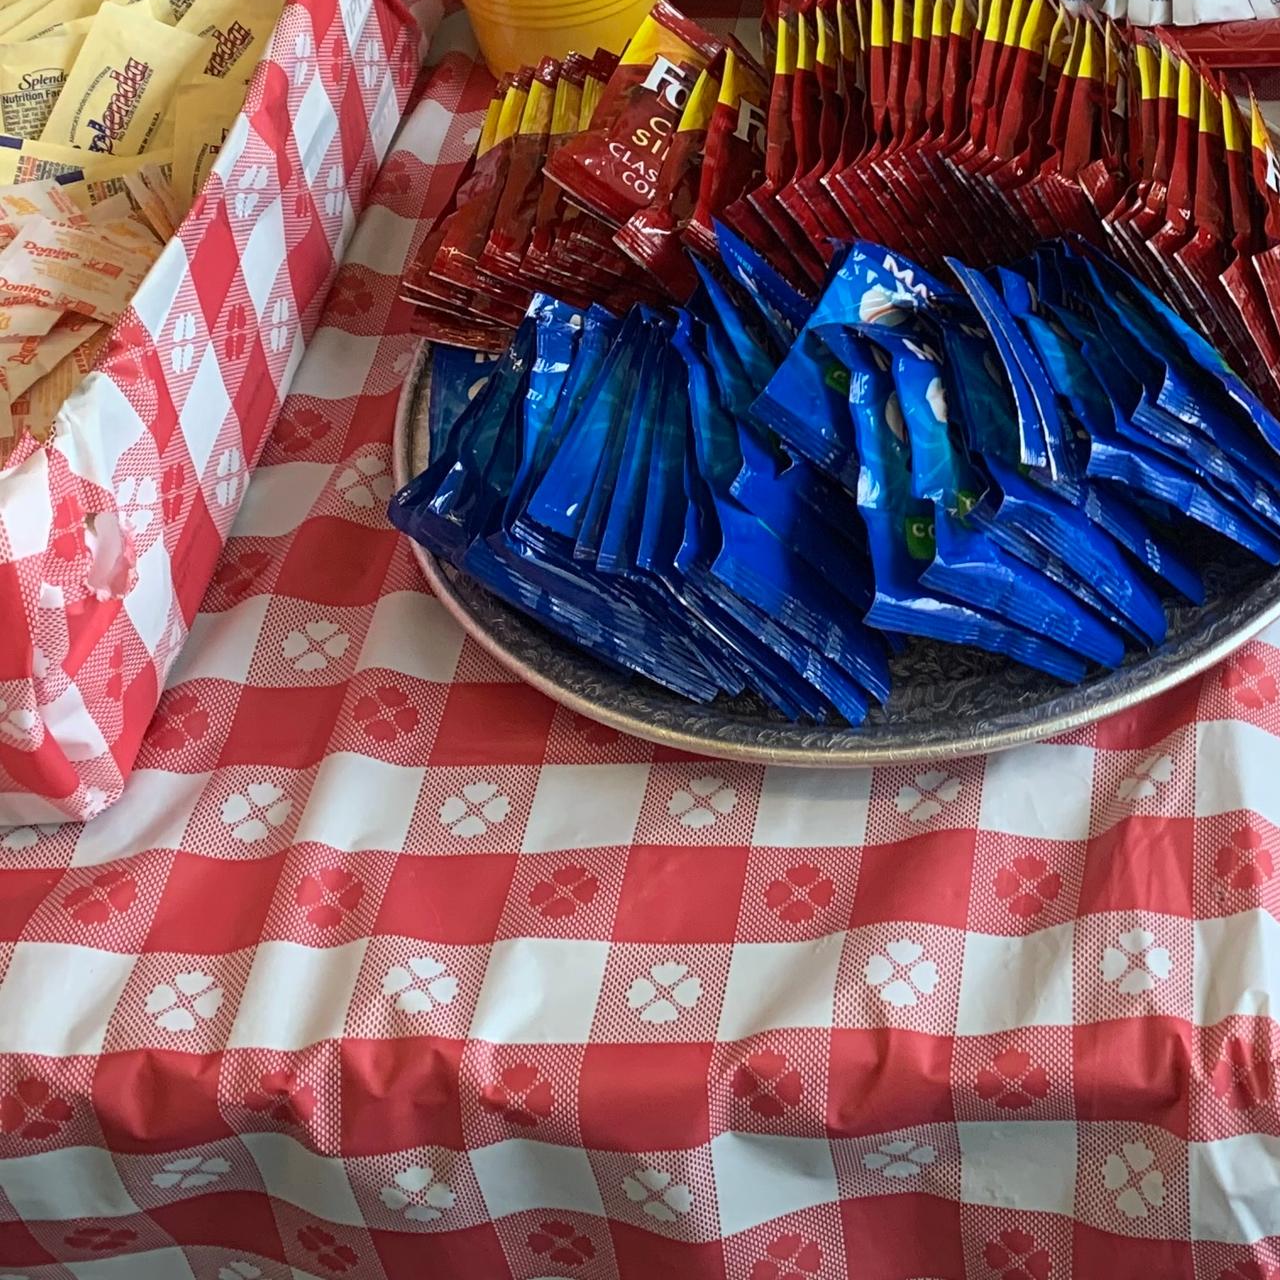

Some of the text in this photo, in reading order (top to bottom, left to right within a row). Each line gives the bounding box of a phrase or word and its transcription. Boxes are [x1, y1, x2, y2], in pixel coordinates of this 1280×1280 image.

[2, 90, 43, 105] Nutrition
[88, 56, 149, 155] plenda
[23, 240, 80, 260] Domino
